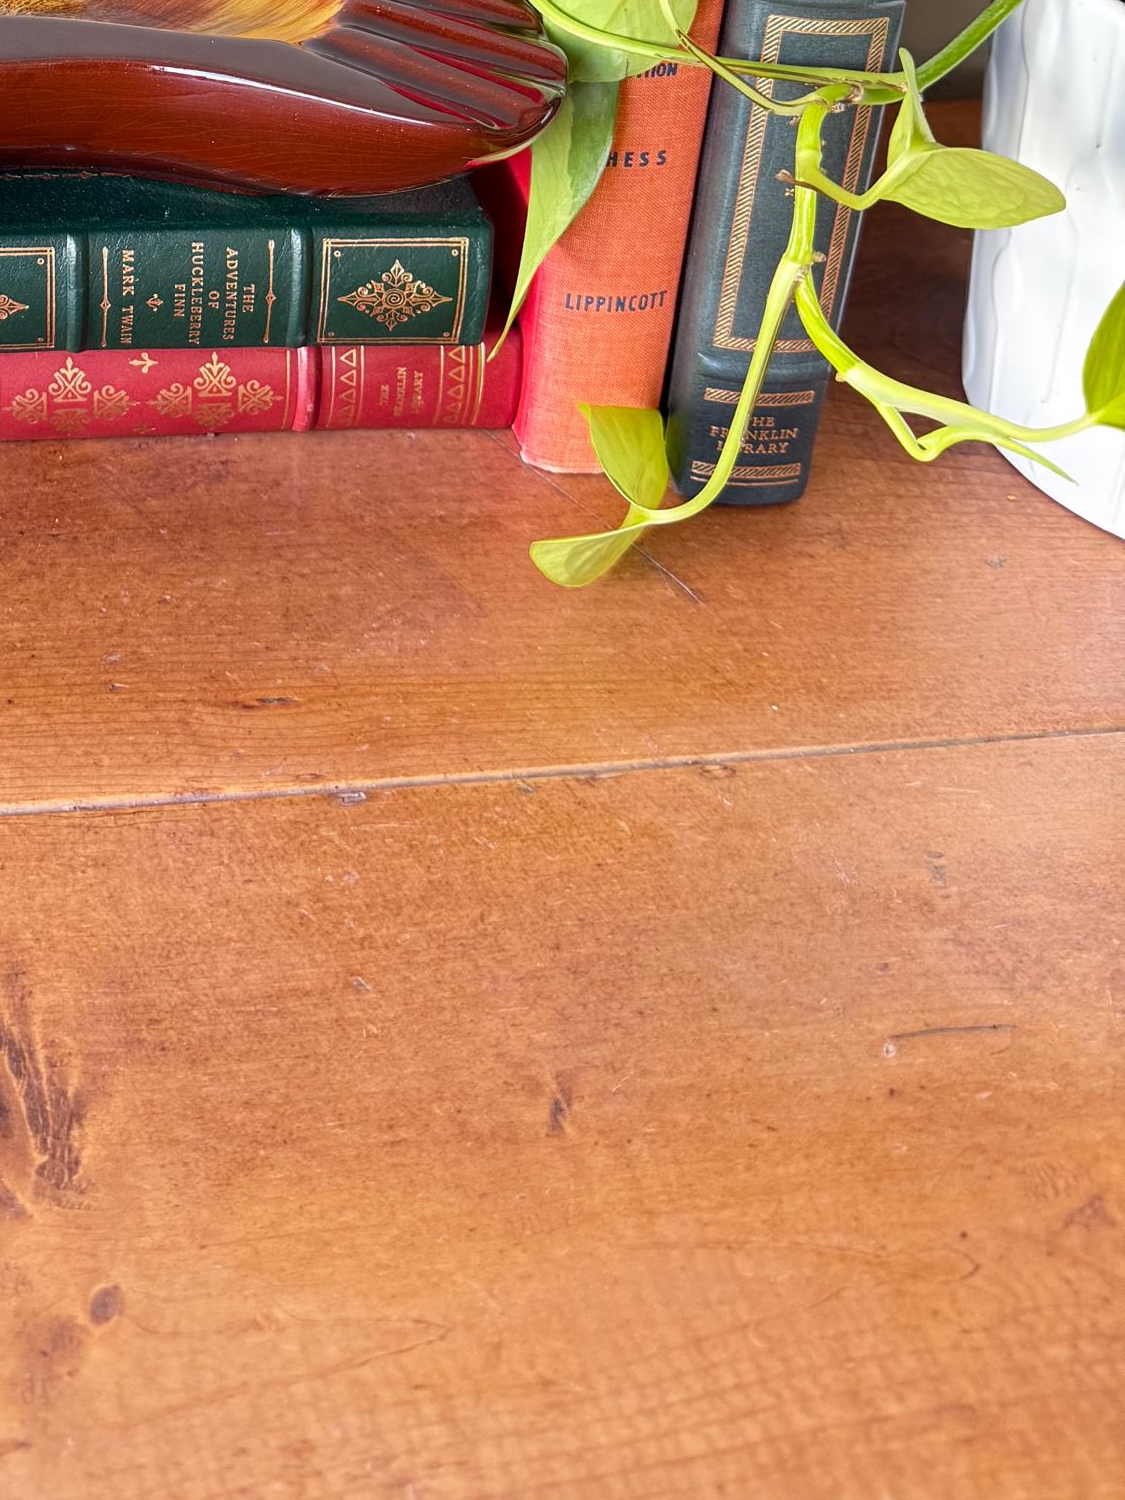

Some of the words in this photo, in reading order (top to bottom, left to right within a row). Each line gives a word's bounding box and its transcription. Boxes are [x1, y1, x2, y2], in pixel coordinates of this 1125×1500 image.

[122, 250, 135, 296] MARK
[174, 283, 186, 317] FINN
[188, 242, 204, 345] HUCKLEBERRY
[208, 290, 220, 309] OF
[222, 246, 239, 340] ADVENTURES
[242, 283, 255, 313] THE
[564, 290, 667, 313] LIPPINCOTT
[120, 305, 134, 344] TWAIN
[708, 425, 798, 441] FRNKLIN
[716, 440, 789, 454] LRARY
